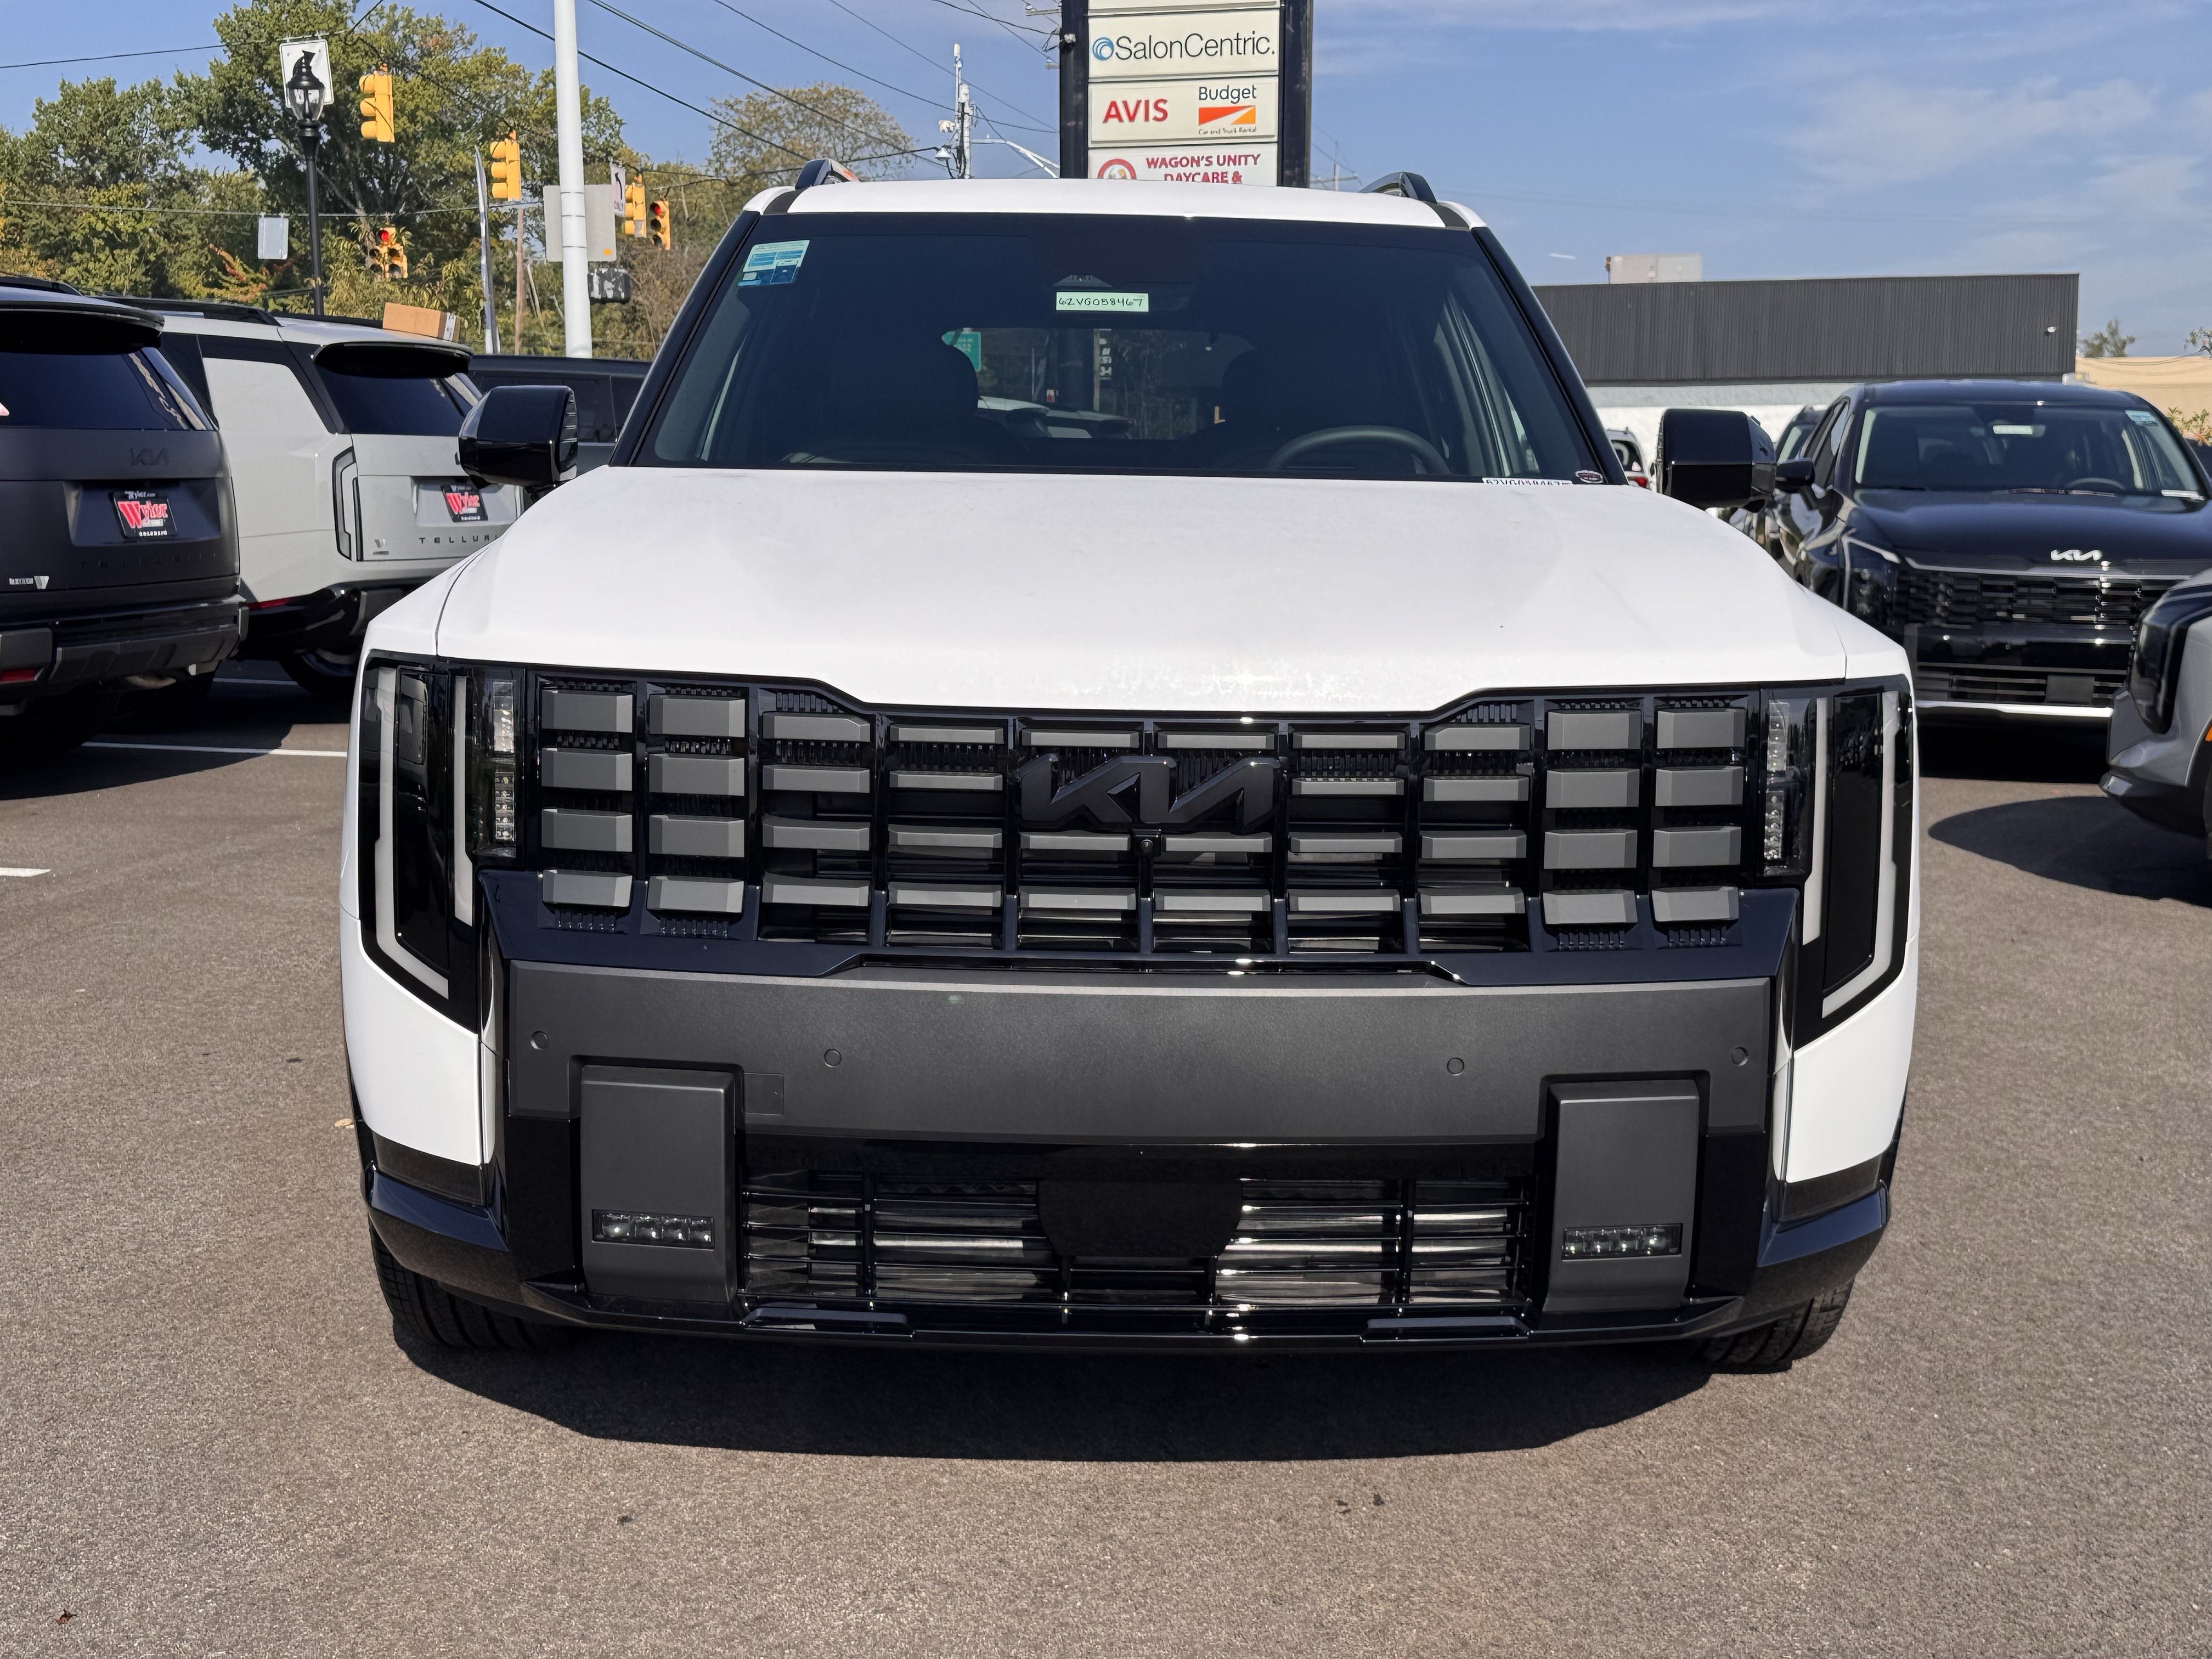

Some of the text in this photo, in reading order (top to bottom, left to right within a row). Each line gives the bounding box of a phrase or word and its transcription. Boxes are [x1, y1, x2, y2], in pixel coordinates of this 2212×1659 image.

[1199, 84, 1257, 104] Budget
[1102, 98, 1169, 123] AVIS
[1146, 154, 1261, 168] WAGON'S UNITY
[1018, 753, 1280, 831] KIA
